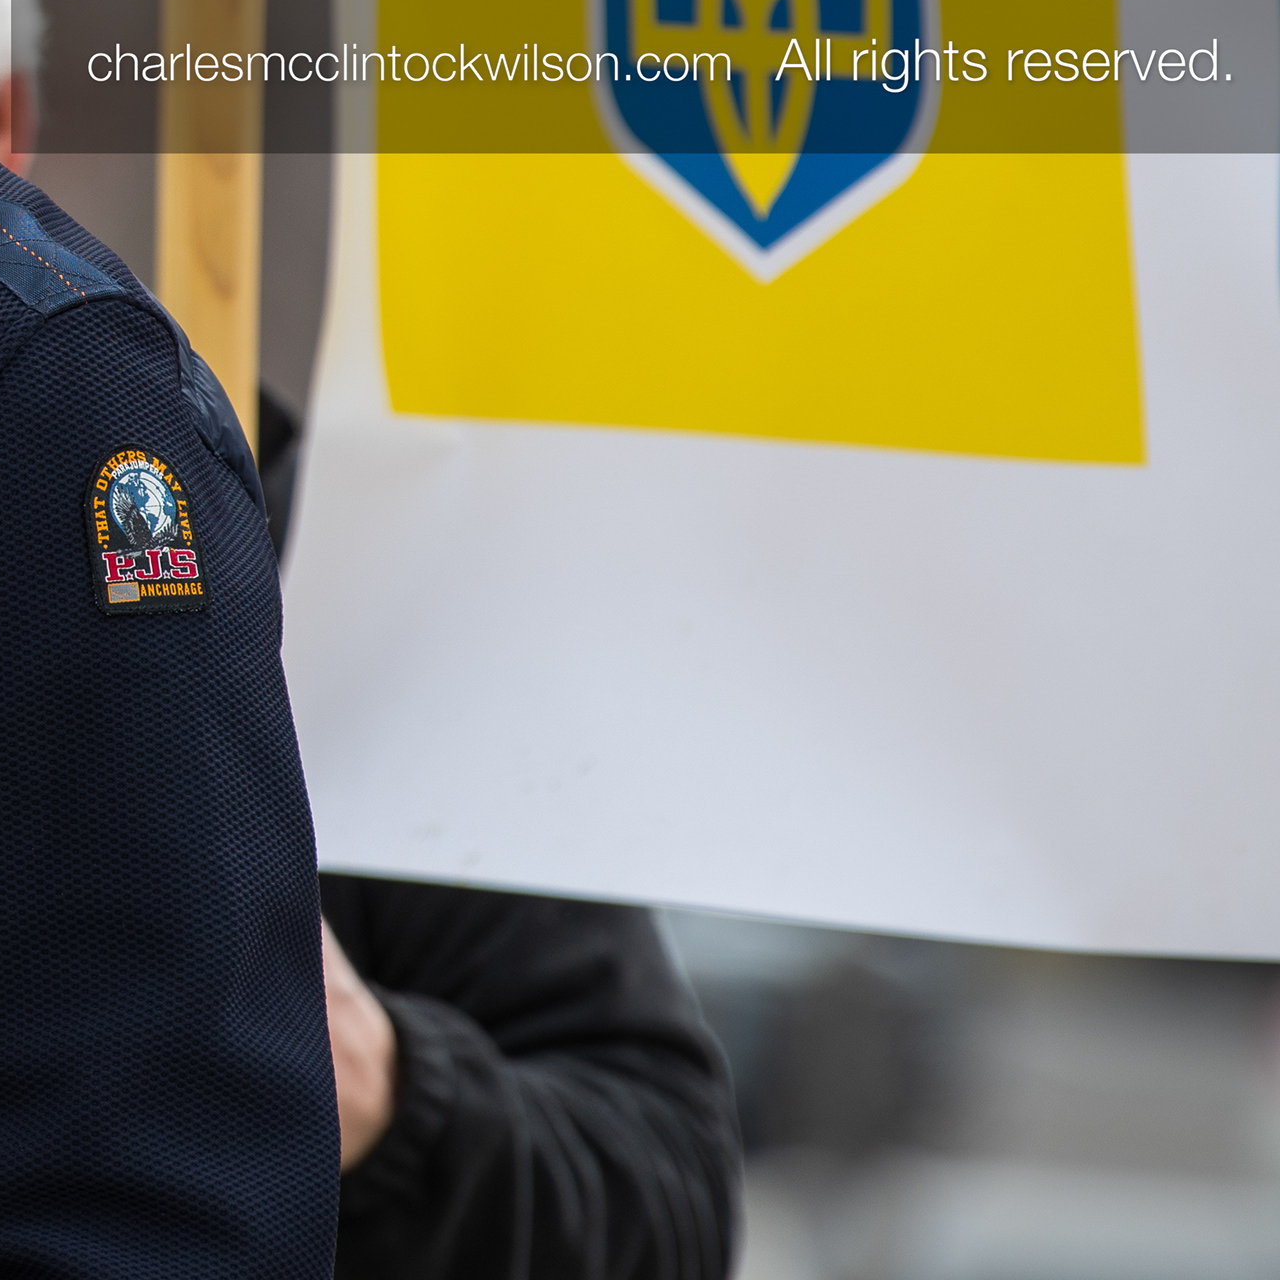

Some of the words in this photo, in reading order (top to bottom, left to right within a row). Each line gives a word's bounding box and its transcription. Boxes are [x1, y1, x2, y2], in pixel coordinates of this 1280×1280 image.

[95, 450, 147, 492] OTHERS
[111, 460, 164, 480] PARAJUMPERS
[152, 456, 183, 493] MAY
[93, 497, 110, 544] THAT
[176, 499, 193, 541] LIVE
[140, 582, 204, 597] ANCHORAGE
